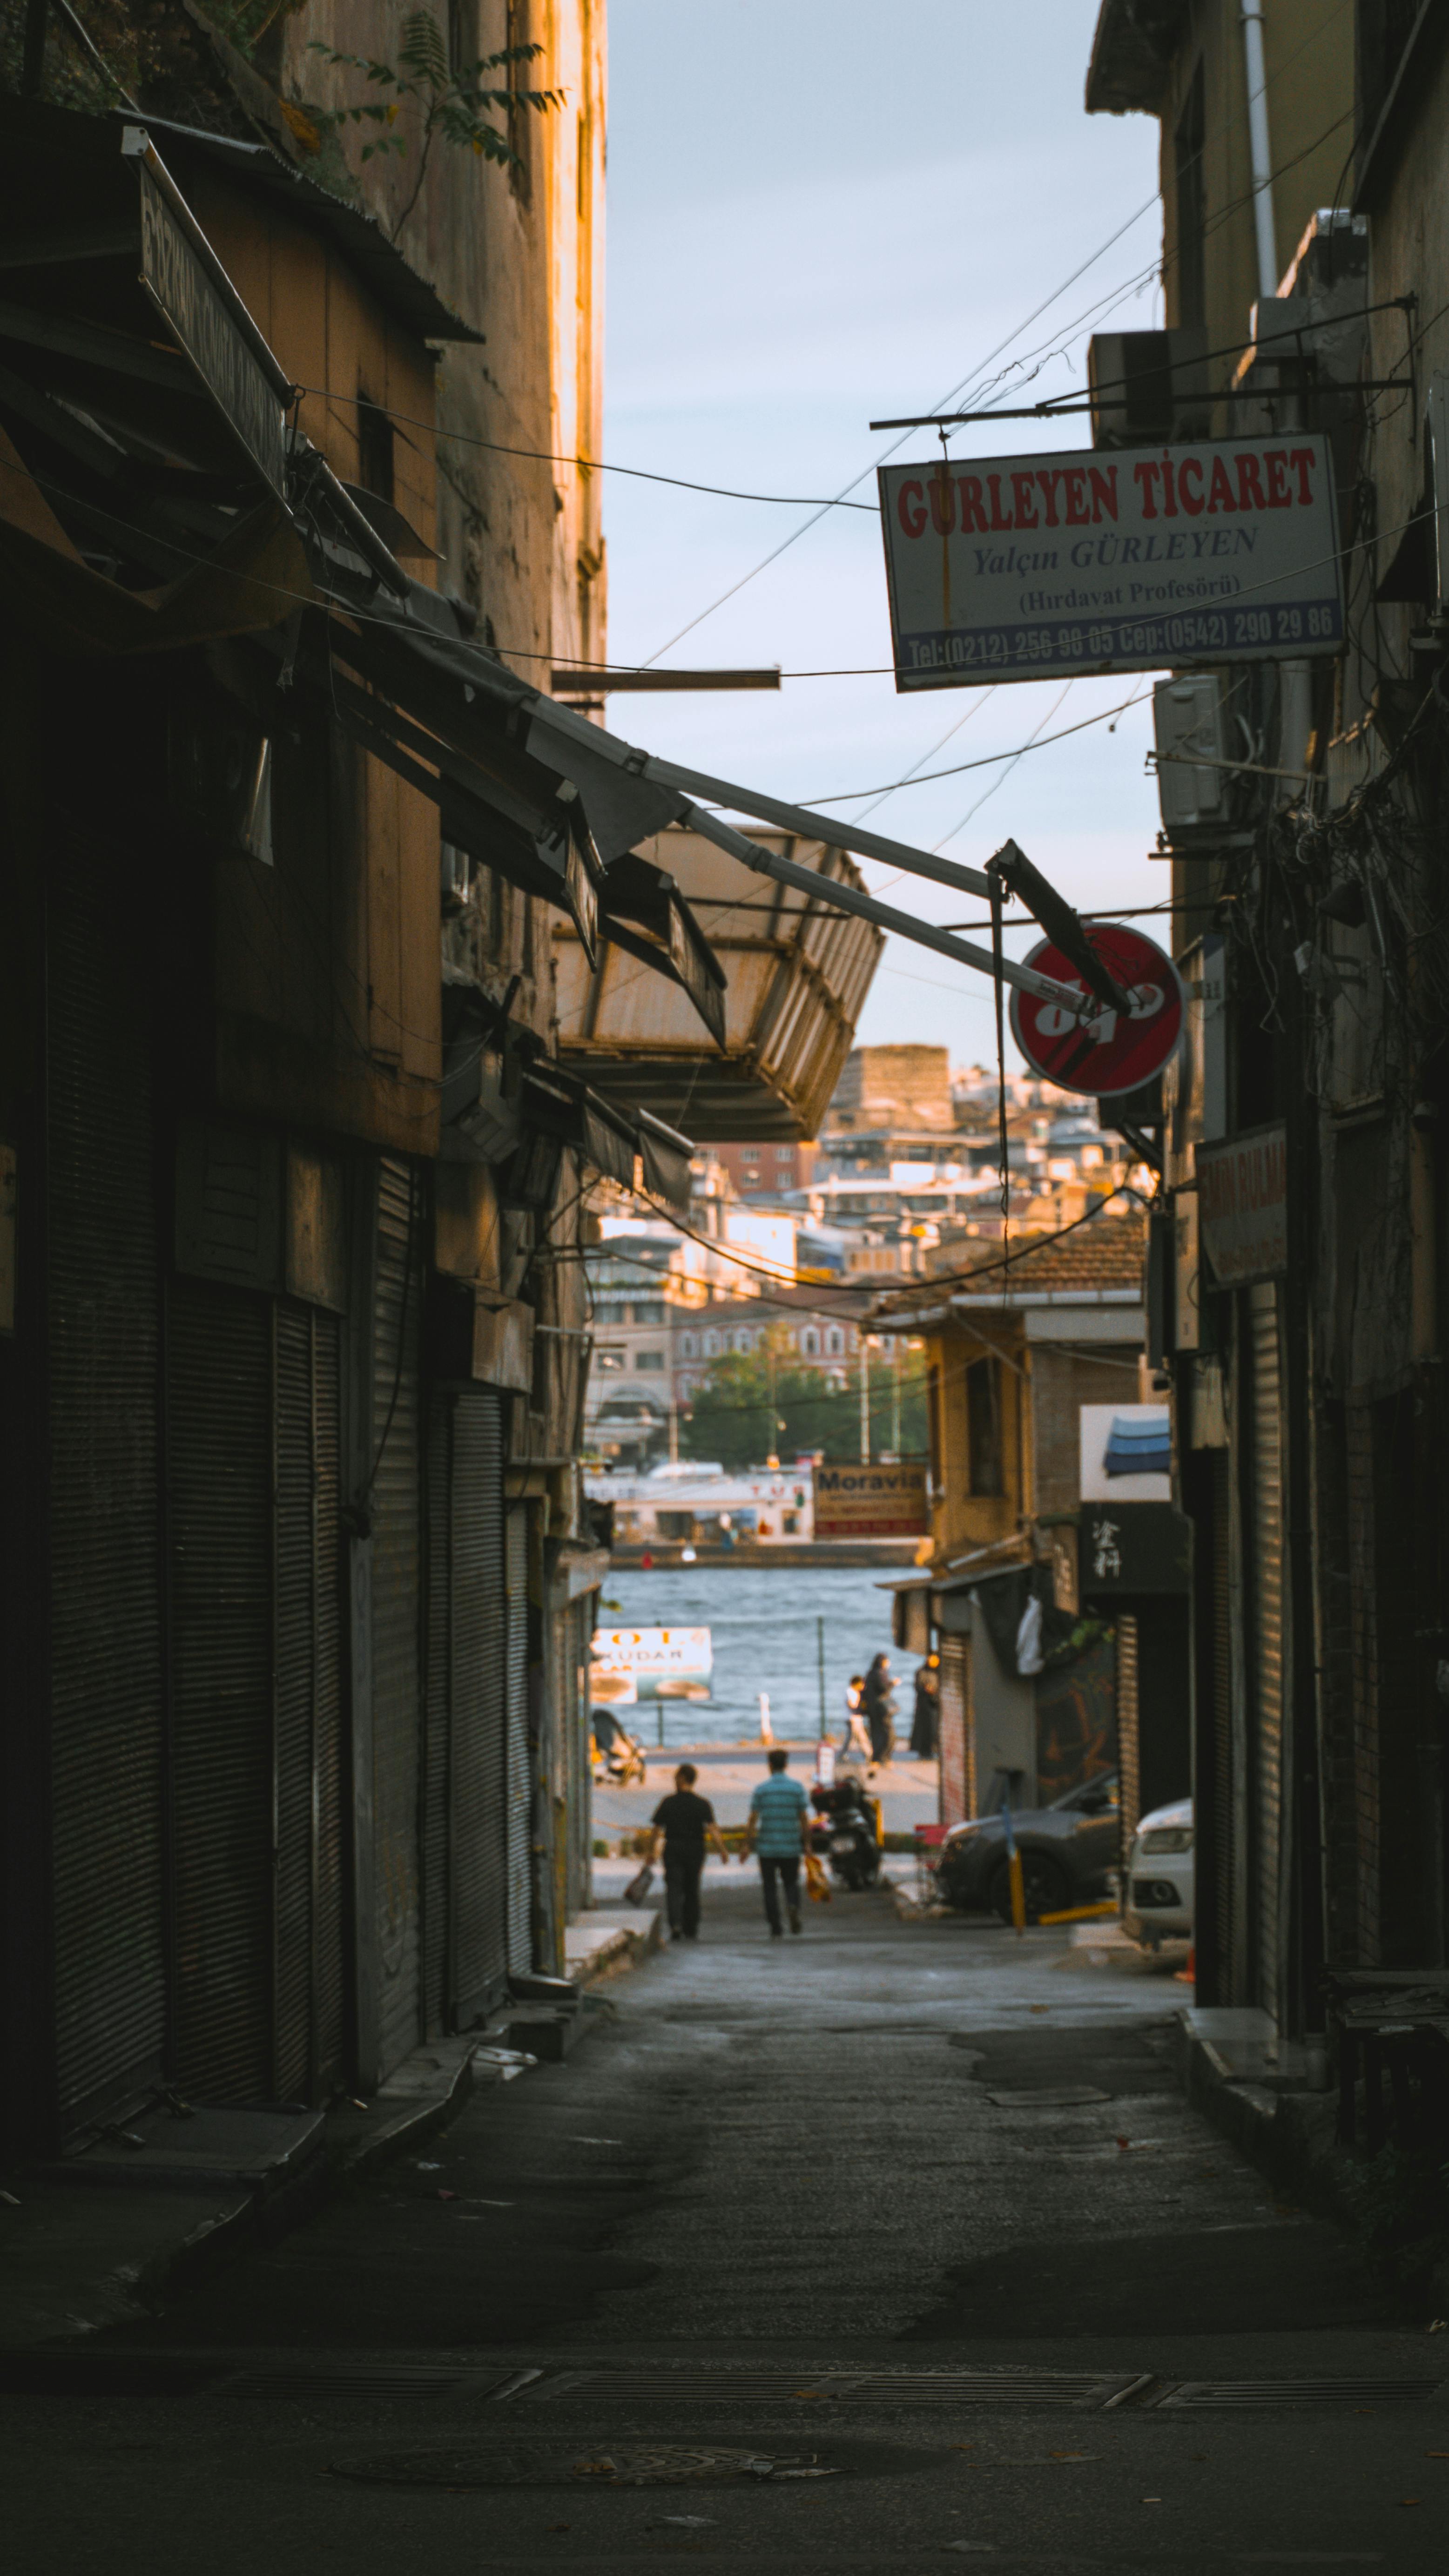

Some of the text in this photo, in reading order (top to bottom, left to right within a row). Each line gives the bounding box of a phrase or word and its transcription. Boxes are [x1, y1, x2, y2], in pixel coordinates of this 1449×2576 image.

[898, 448, 1315, 539] GÜRLEYEN TİCARET
[974, 527, 1260, 578] Yalçın GÜRLEYEN
[1019, 574, 1240, 615] (Hırdavat Profesörü)
[908, 633, 1009, 670] Tel:(0212)
[1014, 630, 1054, 661] 256
[1088, 625, 1114, 655] 05
[1119, 615, 1228, 654] Cep:(0542)
[1233, 611, 1272, 643] 290
[1277, 609, 1302, 640] 29
[1308, 607, 1334, 637] 86
[818, 1471, 922, 1490] Moravia
